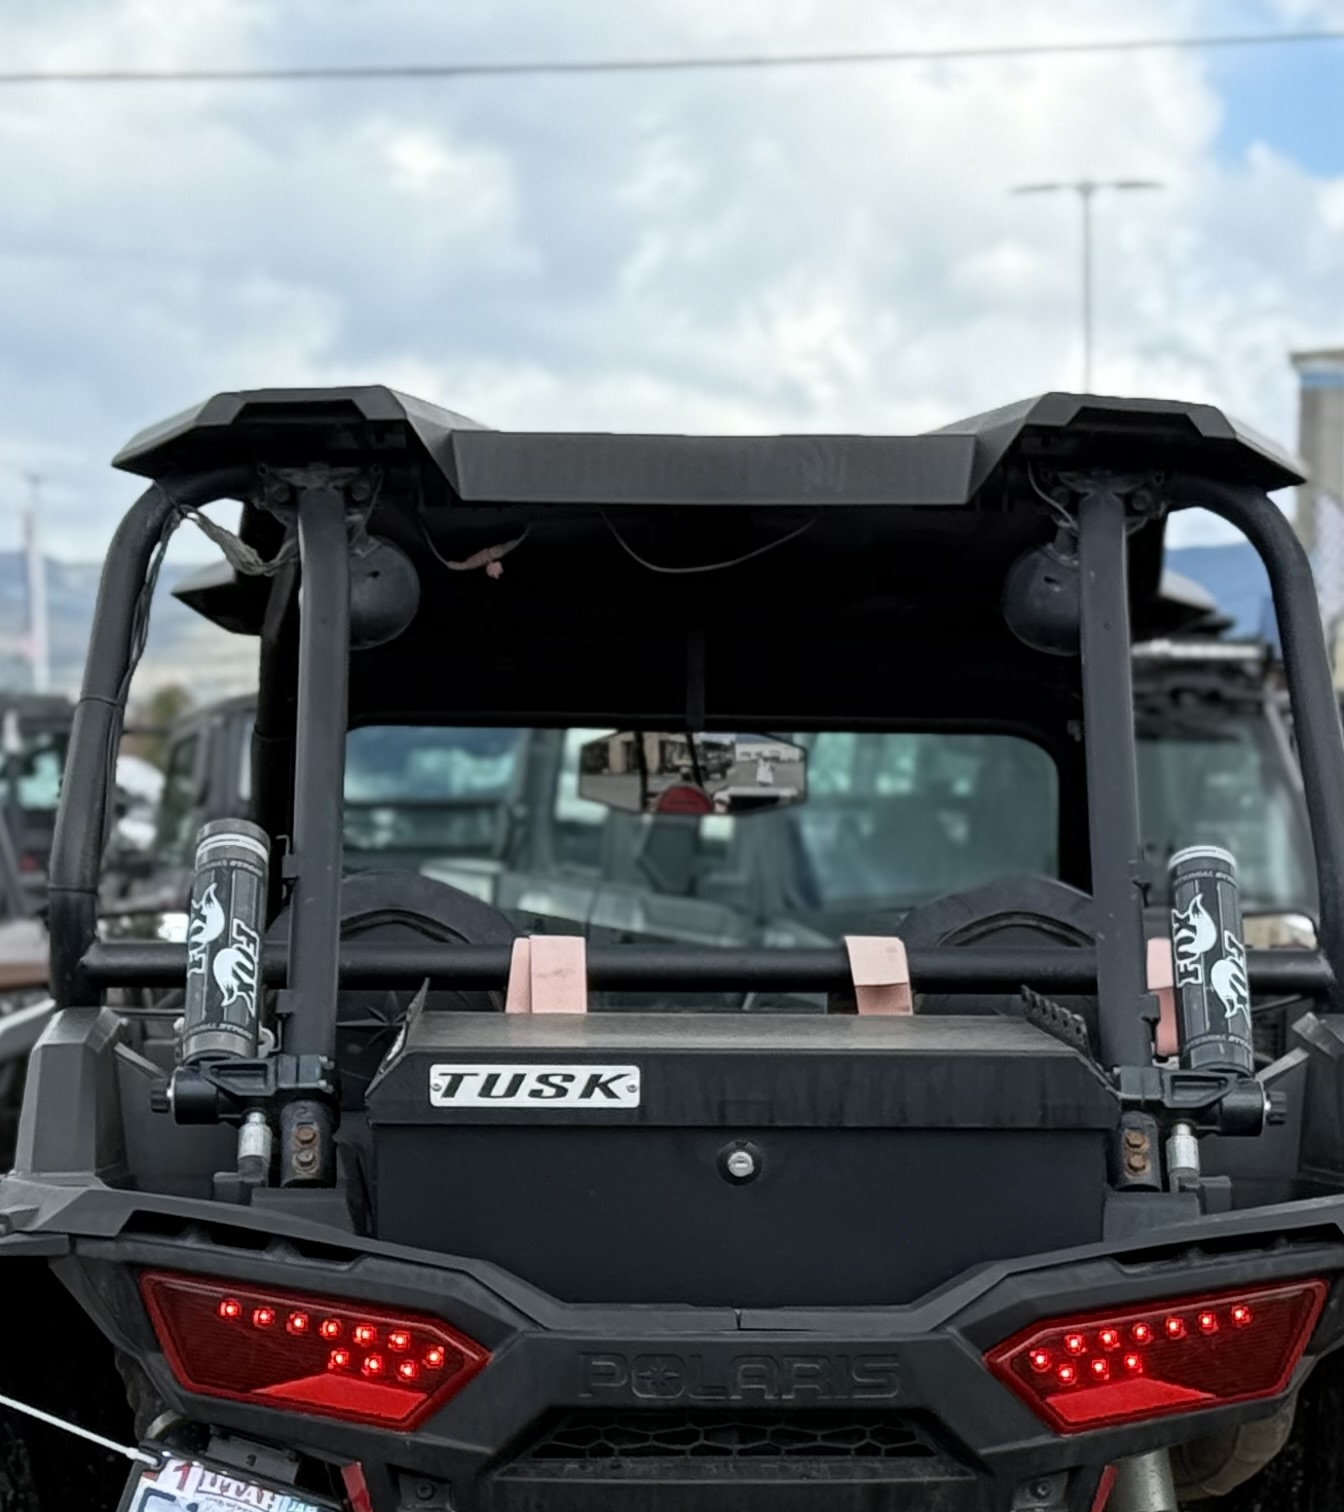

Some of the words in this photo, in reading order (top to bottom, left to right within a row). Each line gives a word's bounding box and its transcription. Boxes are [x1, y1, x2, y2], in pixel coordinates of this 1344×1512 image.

[1171, 893, 1217, 988] FOX
[438, 1072, 633, 1100] TUSK
[578, 1352, 901, 1400] POLARIS
